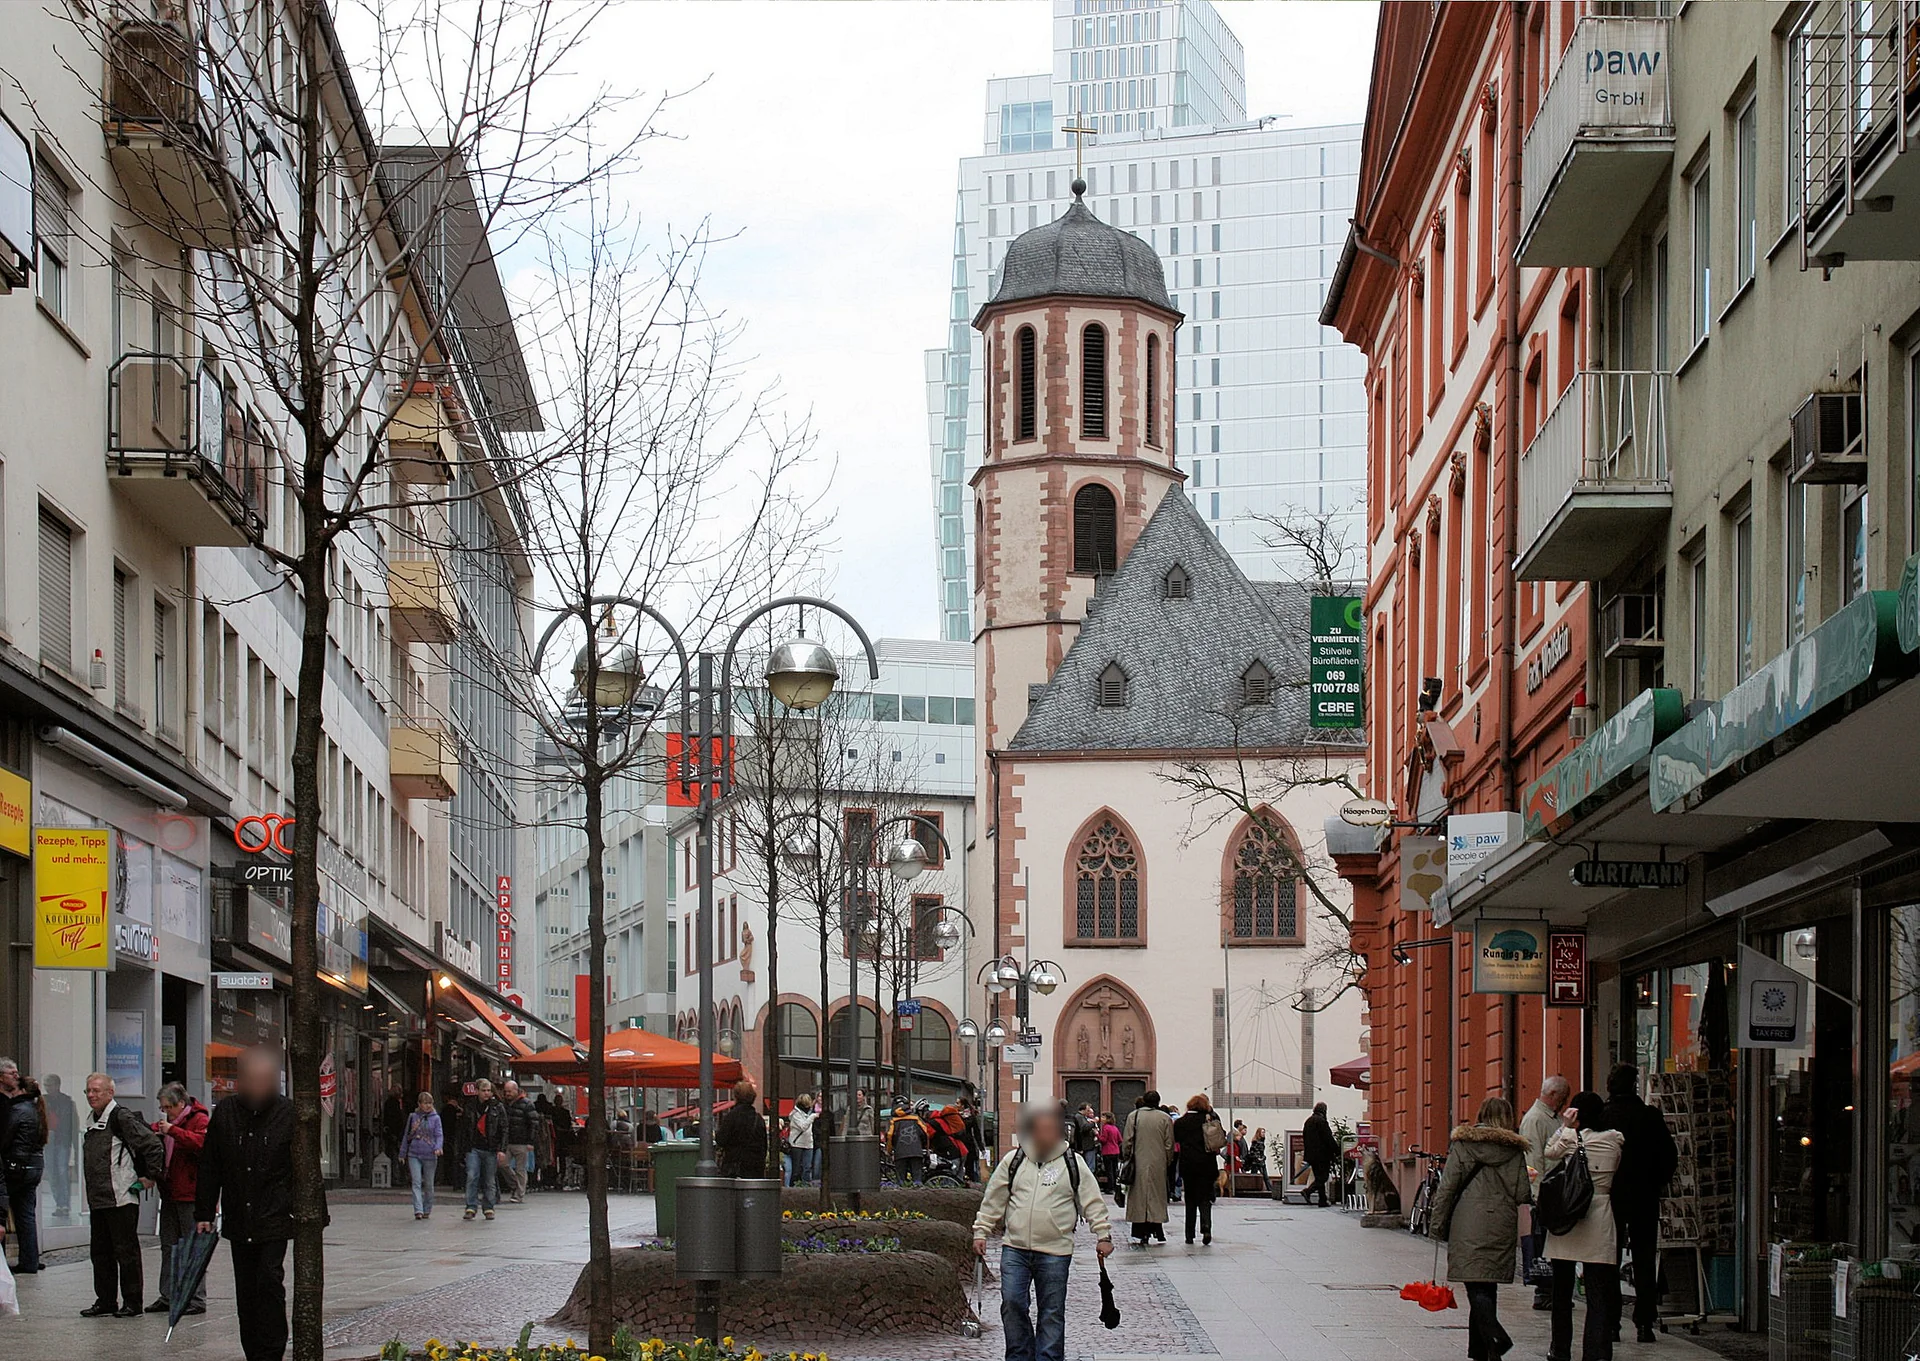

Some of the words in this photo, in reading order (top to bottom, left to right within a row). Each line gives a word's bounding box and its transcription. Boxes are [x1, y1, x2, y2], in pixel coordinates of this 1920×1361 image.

[1586, 49, 1661, 84] paw
[1329, 627, 1342, 635] ZU
[1312, 635, 1360, 643] VERMIETEN
[1319, 646, 1352, 655] Stilvolle
[1312, 656, 1360, 665] Büroflächen
[1326, 670, 1346, 681] 069
[1318, 702, 1355, 713] CBRE
[37, 835, 78, 849] Rezepte,
[80, 836, 106, 849] Tipps
[1476, 834, 1501, 847] paw
[51, 853, 70, 864] und
[73, 853, 106, 864] mehr...
[1449, 852, 1477, 862] people
[245, 866, 294, 882] OPTIK
[1581, 863, 1685, 884] HARTMANN
[1556, 937, 1579, 949] Anh
[1483, 947, 1519, 961] Running
[1560, 949, 1574, 960] Ky
[1555, 959, 1580, 970] Food
[220, 975, 261, 986] swatch
[1756, 1028, 1770, 1038] TAX
[1770, 1029, 1789, 1038] FREE
